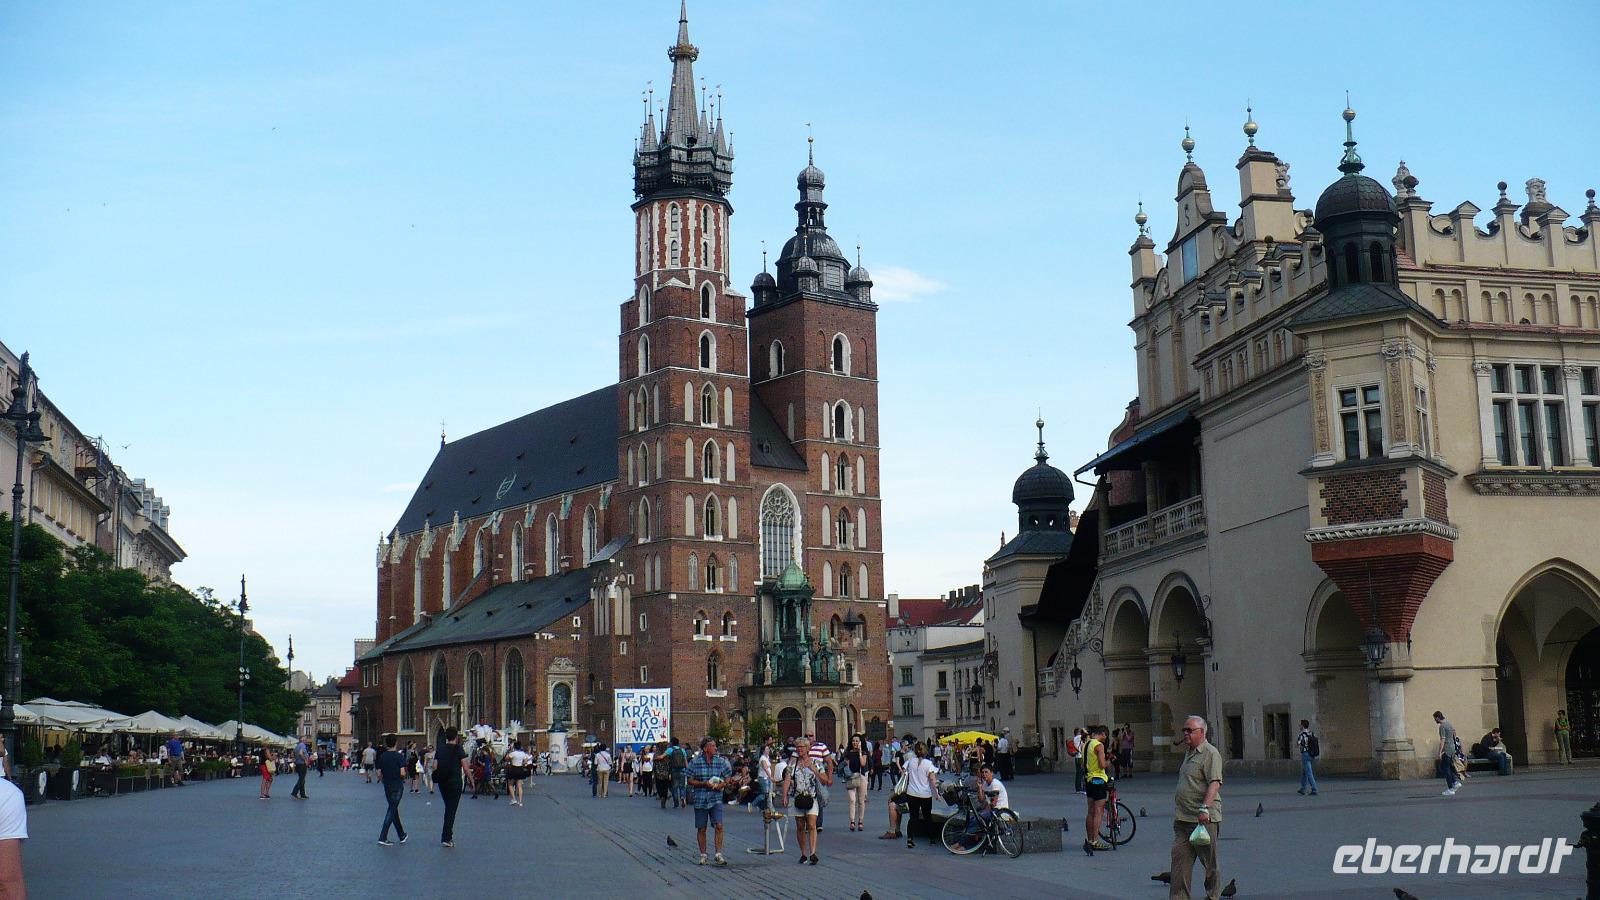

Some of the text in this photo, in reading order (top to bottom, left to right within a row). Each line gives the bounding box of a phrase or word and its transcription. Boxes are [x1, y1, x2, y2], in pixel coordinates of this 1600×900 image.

[640, 695, 664, 707] DNI
[621, 706, 651, 718] KRA
[632, 729, 655, 742] WA
